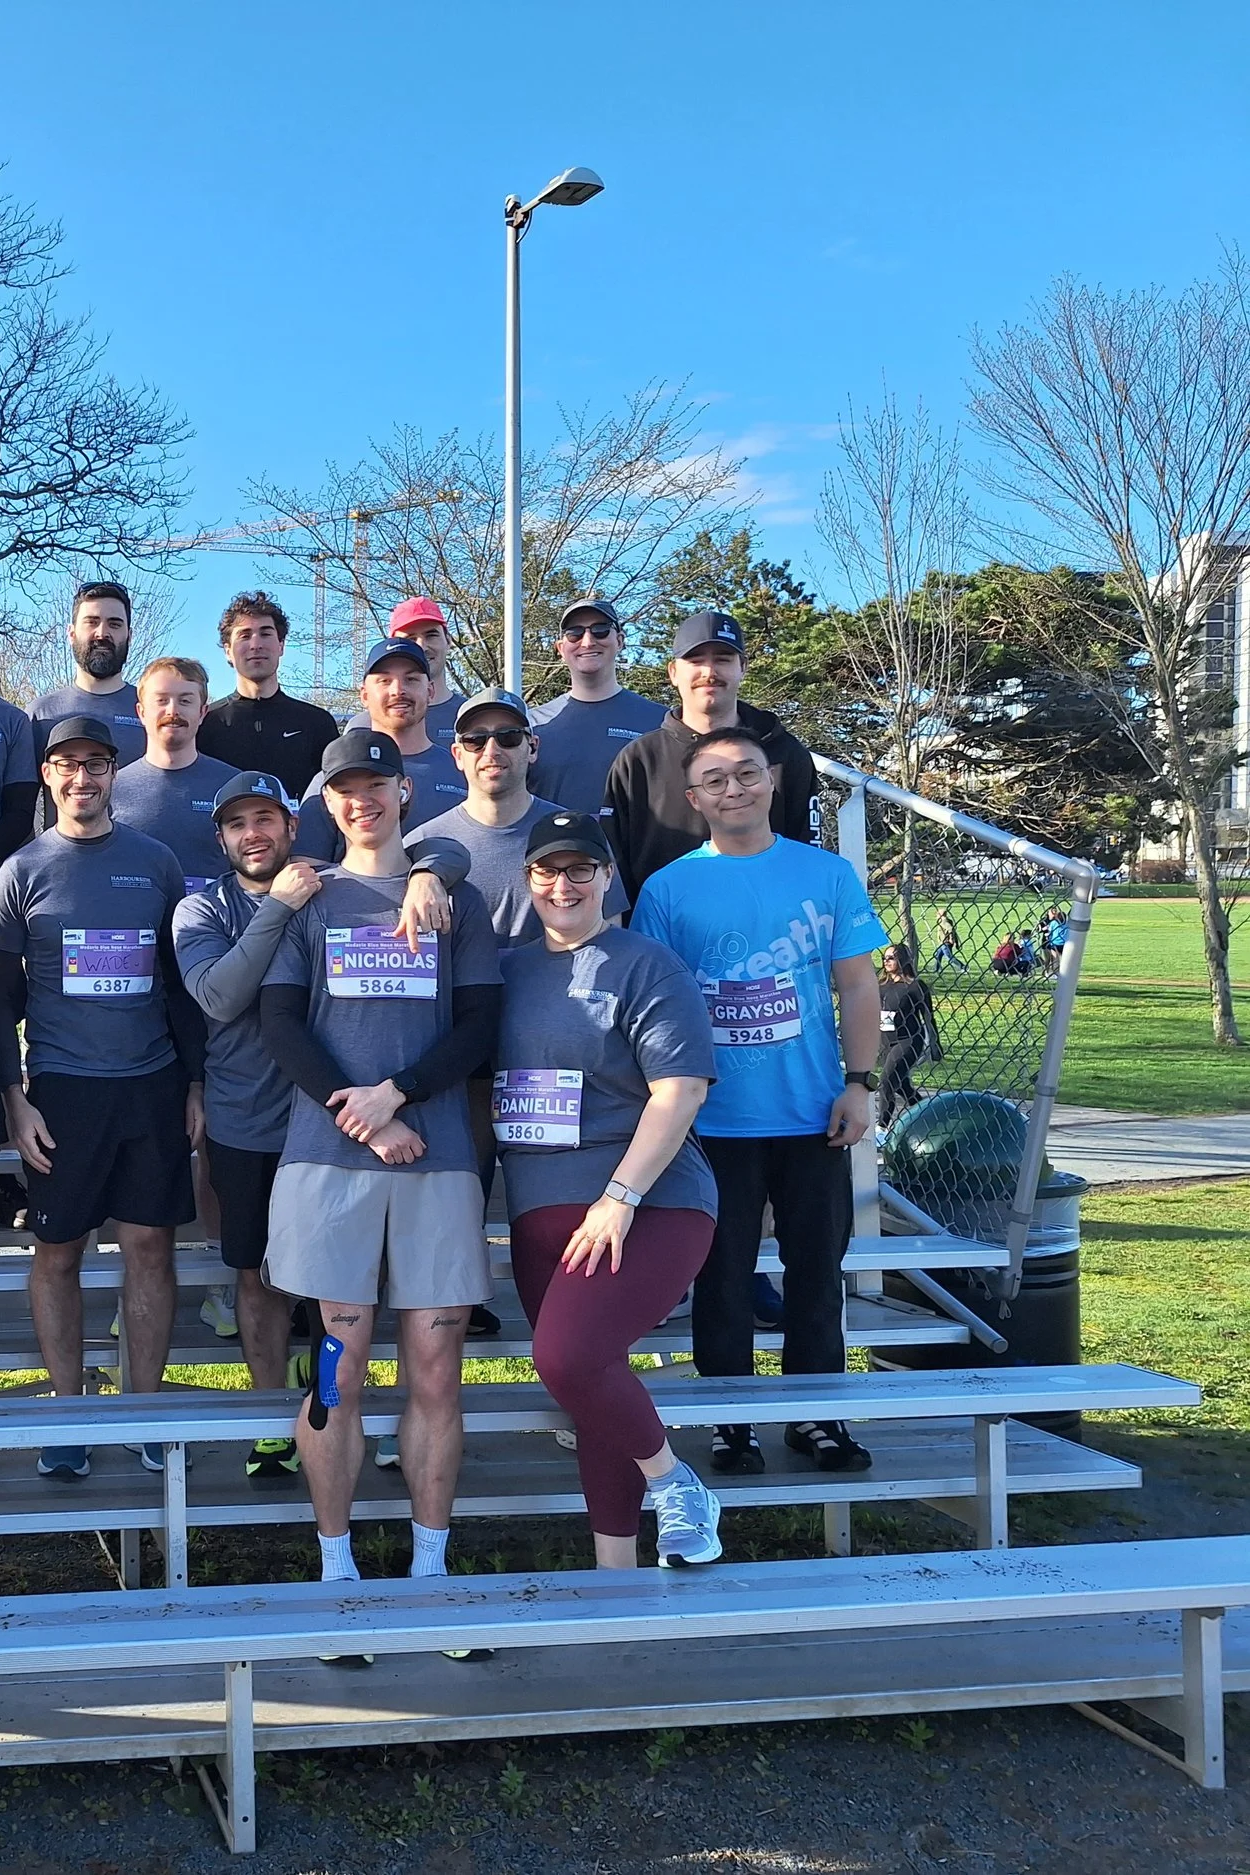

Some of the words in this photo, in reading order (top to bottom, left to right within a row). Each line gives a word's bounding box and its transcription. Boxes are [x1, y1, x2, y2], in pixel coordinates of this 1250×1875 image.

[853, 913, 871, 928] BLUE
[84, 954, 131, 971] WADE
[344, 953, 436, 969] NICHOLAS
[93, 980, 130, 992] 6387
[360, 980, 406, 993] 5864
[715, 997, 796, 1020] GRAYSON
[729, 1028, 774, 1042] 5948
[500, 1098, 578, 1116] DANIELLE
[508, 1126, 544, 1140] 5860
[331, 1314, 360, 1326] always
